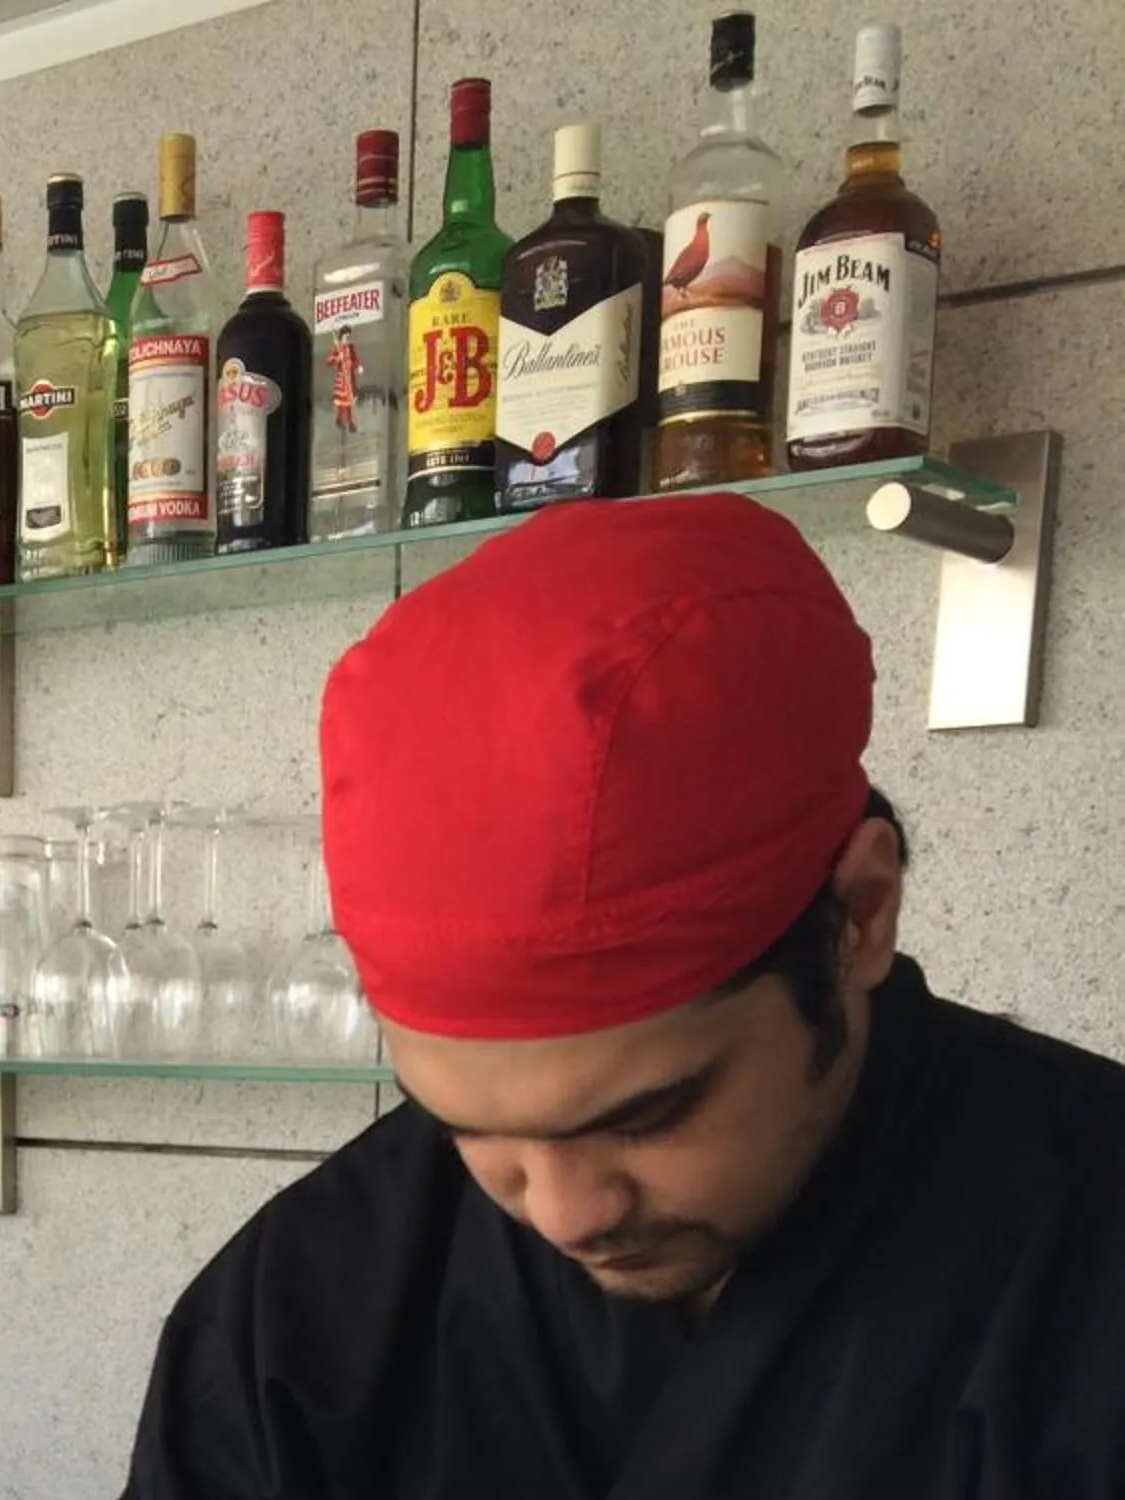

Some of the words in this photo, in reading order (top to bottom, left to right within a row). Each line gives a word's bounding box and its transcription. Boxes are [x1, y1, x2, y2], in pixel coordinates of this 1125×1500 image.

[798, 264, 832, 309] JIM
[835, 254, 891, 293] BEAM
[316, 289, 381, 323] BEEFEATER
[663, 326, 726, 353] AMOUS
[413, 325, 493, 415] J&B
[503, 340, 602, 383] Ballantine's
[158, 500, 201, 517] VODKA
